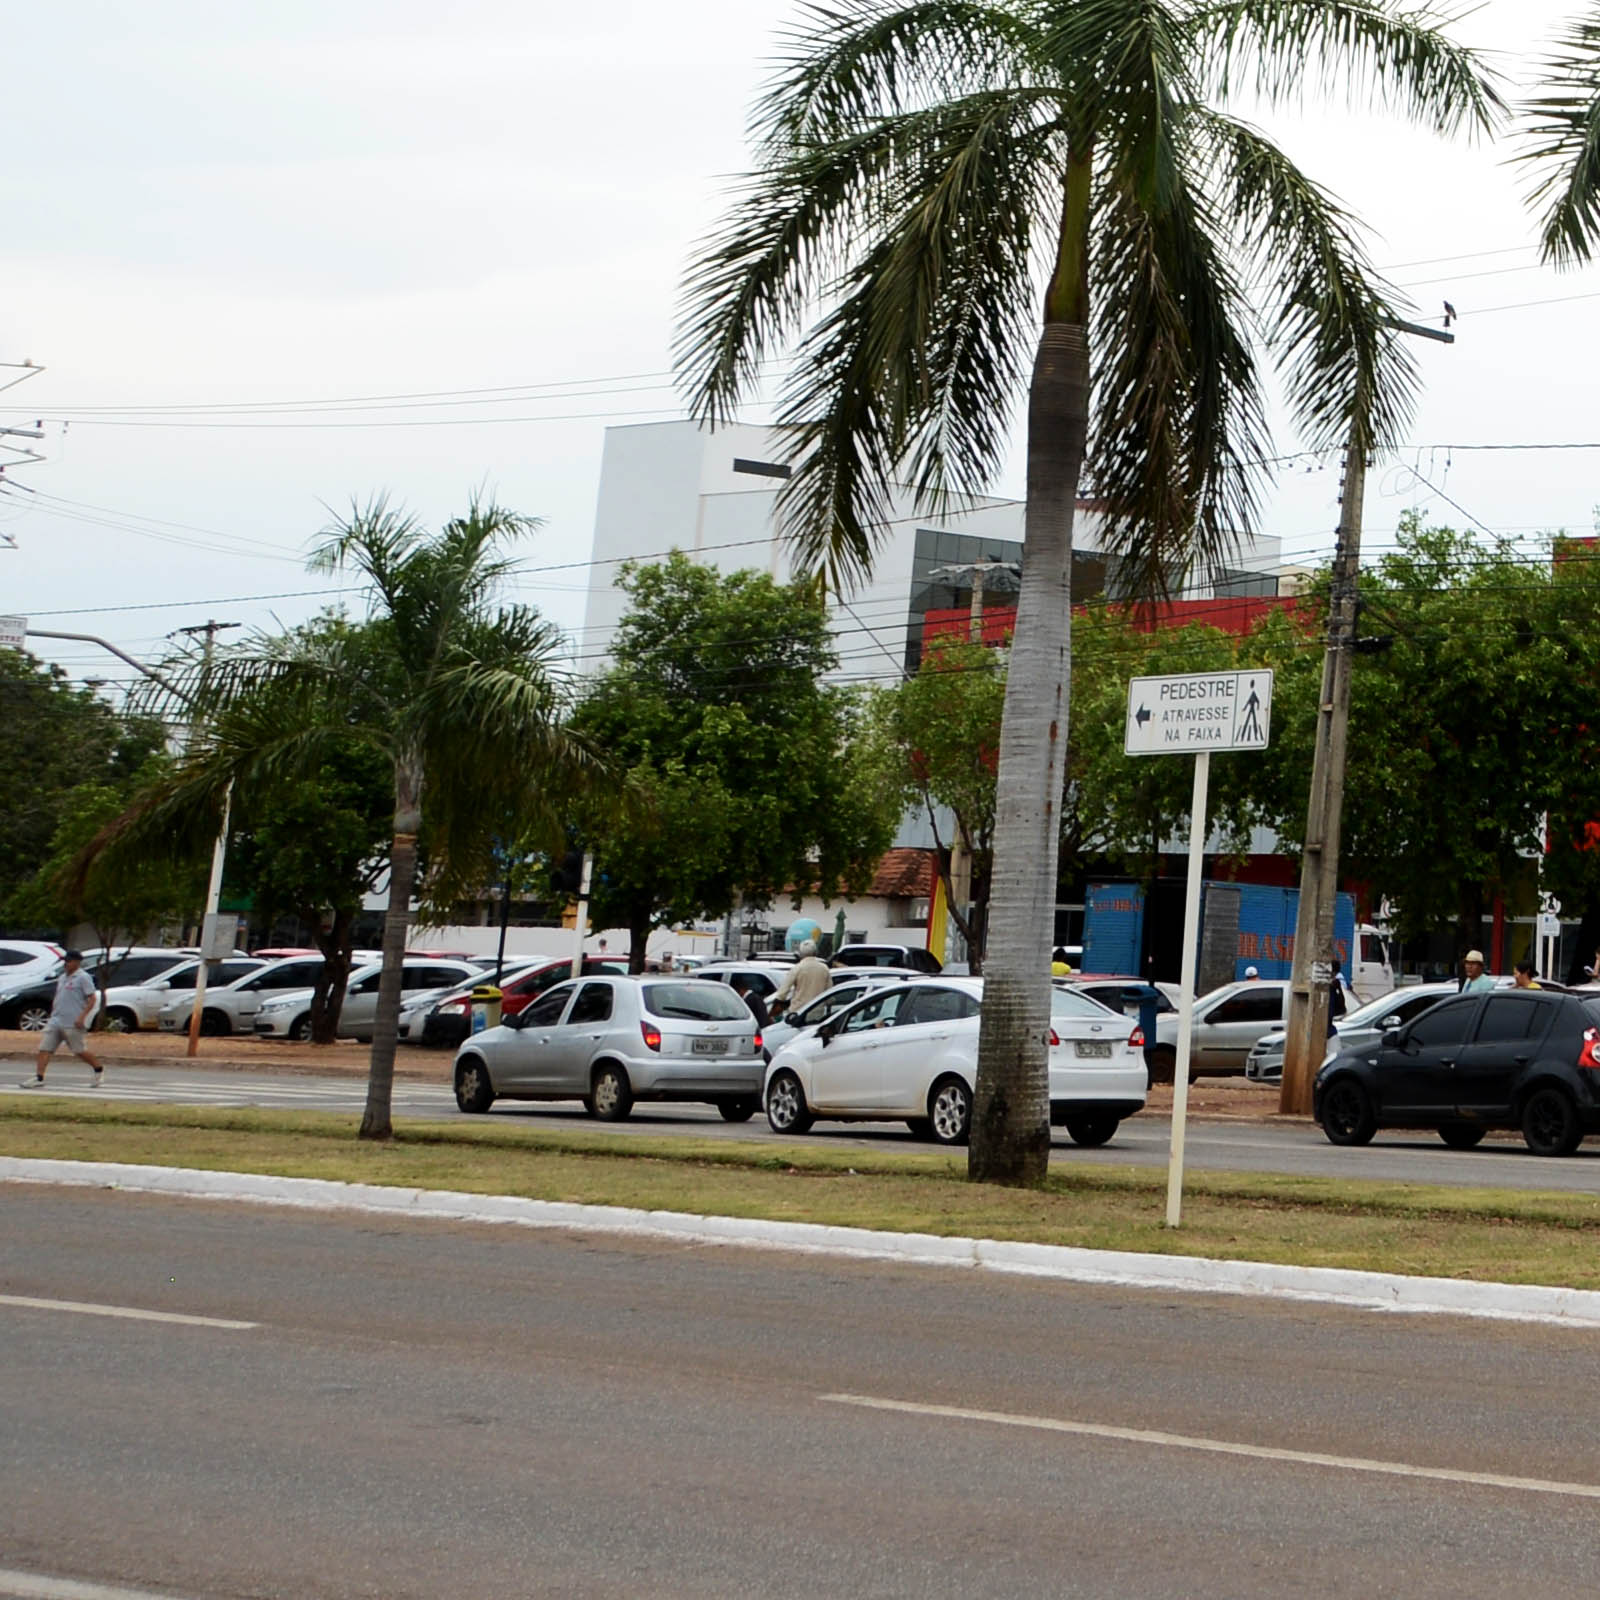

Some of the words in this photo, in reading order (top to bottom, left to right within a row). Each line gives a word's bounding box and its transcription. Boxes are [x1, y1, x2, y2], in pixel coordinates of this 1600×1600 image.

[1160, 680, 1236, 701] PEDESTRE
[1162, 706, 1230, 723] ATRAVESSE
[1164, 728, 1180, 743] NA
[1188, 727, 1222, 741] FAIXA
